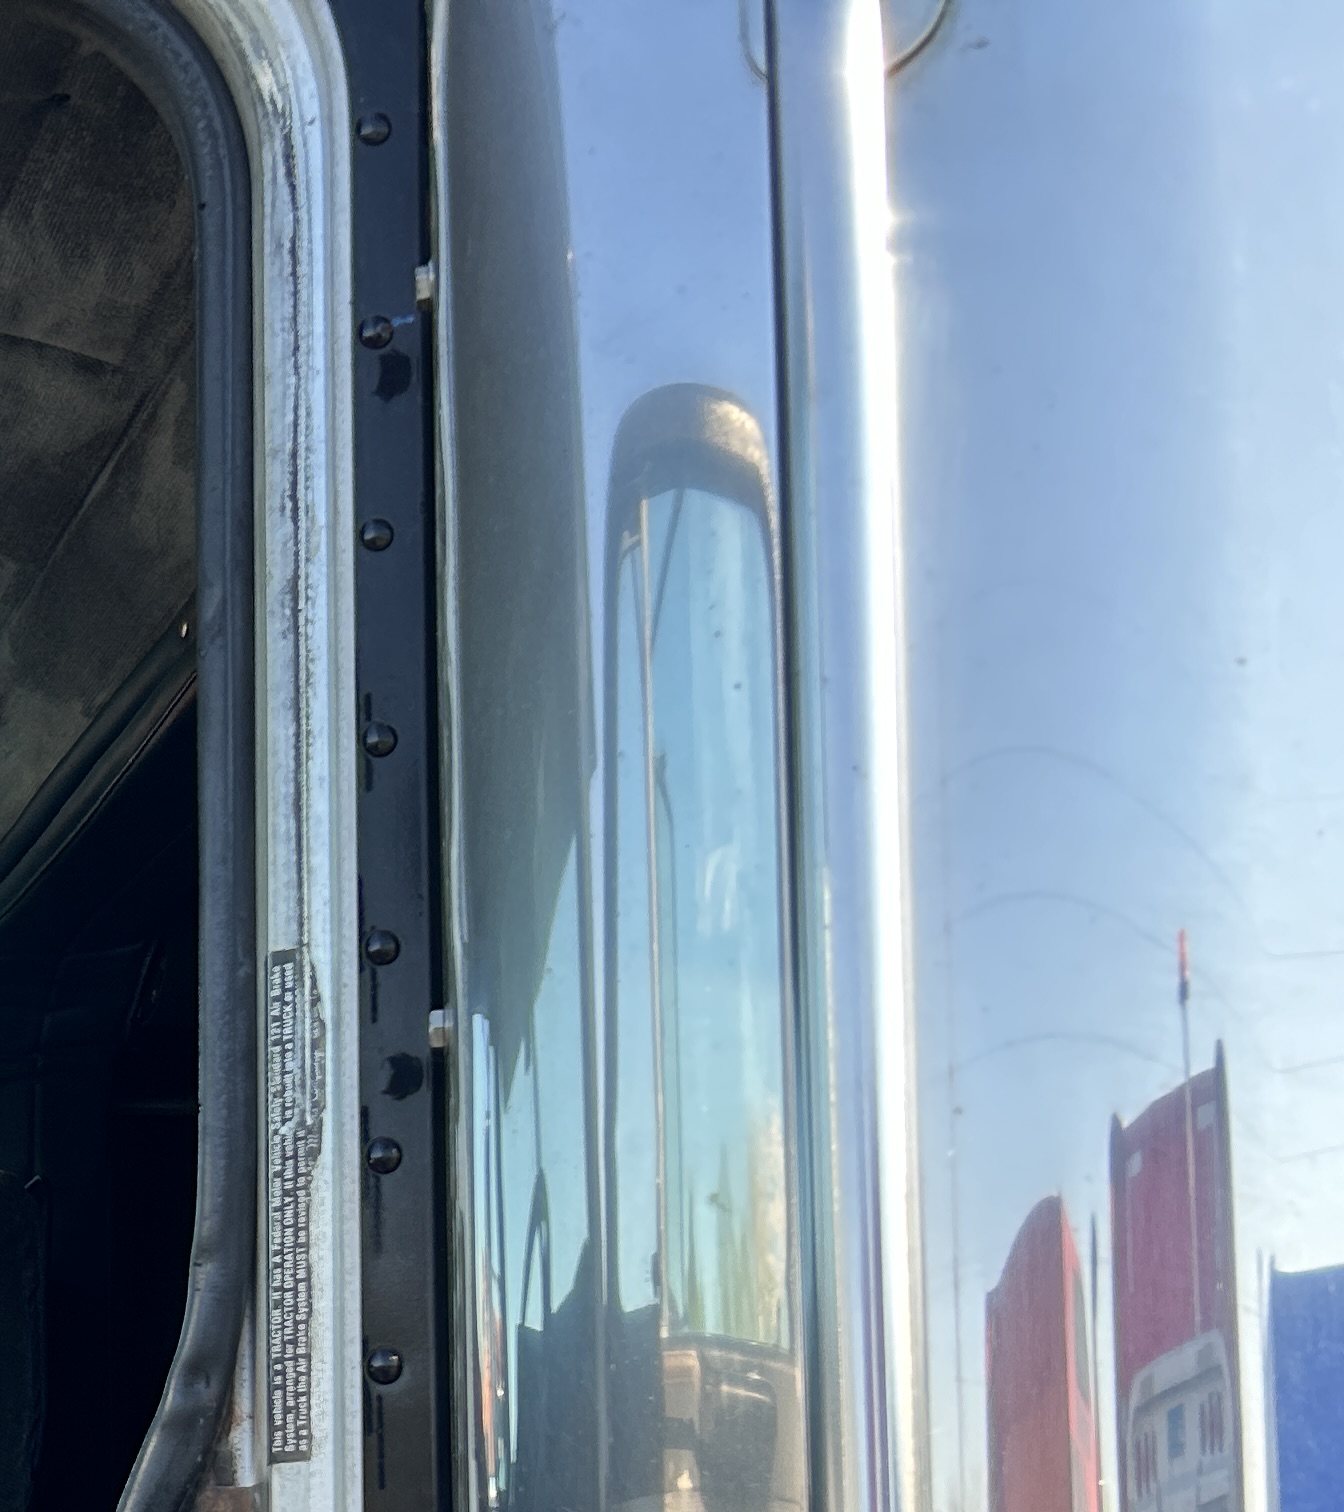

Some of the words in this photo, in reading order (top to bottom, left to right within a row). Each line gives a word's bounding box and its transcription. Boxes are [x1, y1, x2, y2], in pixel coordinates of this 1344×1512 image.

[271, 964, 282, 997] Brake
[283, 962, 294, 988] used
[271, 1001, 282, 1017] Air
[283, 991, 294, 1002] or
[271, 1021, 282, 1040] 121
[283, 1003, 294, 1041] TRUCK
[283, 1073, 294, 1107] rebuilt
[270, 1097, 283, 1129] Safety
[283, 1109, 294, 1118] is
[296, 1129, 307, 1138] it
[271, 1134, 282, 1172] Vehicle
[295, 1140, 308, 1173] permit
[283, 1159, 294, 1179] this
[296, 1176, 307, 1187] to
[271, 1178, 282, 1207] Motor
[283, 1181, 294, 1189] If
[296, 1190, 307, 1227] revised
[271, 1211, 282, 1251] Federal
[296, 1230, 307, 1243] be
[271, 1254, 282, 1263] A
[283, 1228, 294, 1288] OPERATION
[296, 1247, 307, 1279] MUST
[271, 1268, 282, 1287] has
[271, 1291, 282, 1300] It
[296, 1282, 309, 1320] System
[283, 1291, 294, 1341] TRACTOR
[271, 1305, 282, 1359] TRACTOR.
[296, 1323, 307, 1354] Brake
[283, 1344, 294, 1358] for
[296, 1358, 307, 1373] Air
[271, 1375, 282, 1384] is
[284, 1360, 296, 1406] arranged
[296, 1375, 307, 1392] the
[271, 1389, 282, 1426] vehicle
[296, 1396, 307, 1427] Truck
[271, 1431, 282, 1452] This
[284, 1410, 296, 1452] System,
[296, 1439, 307, 1451] as
